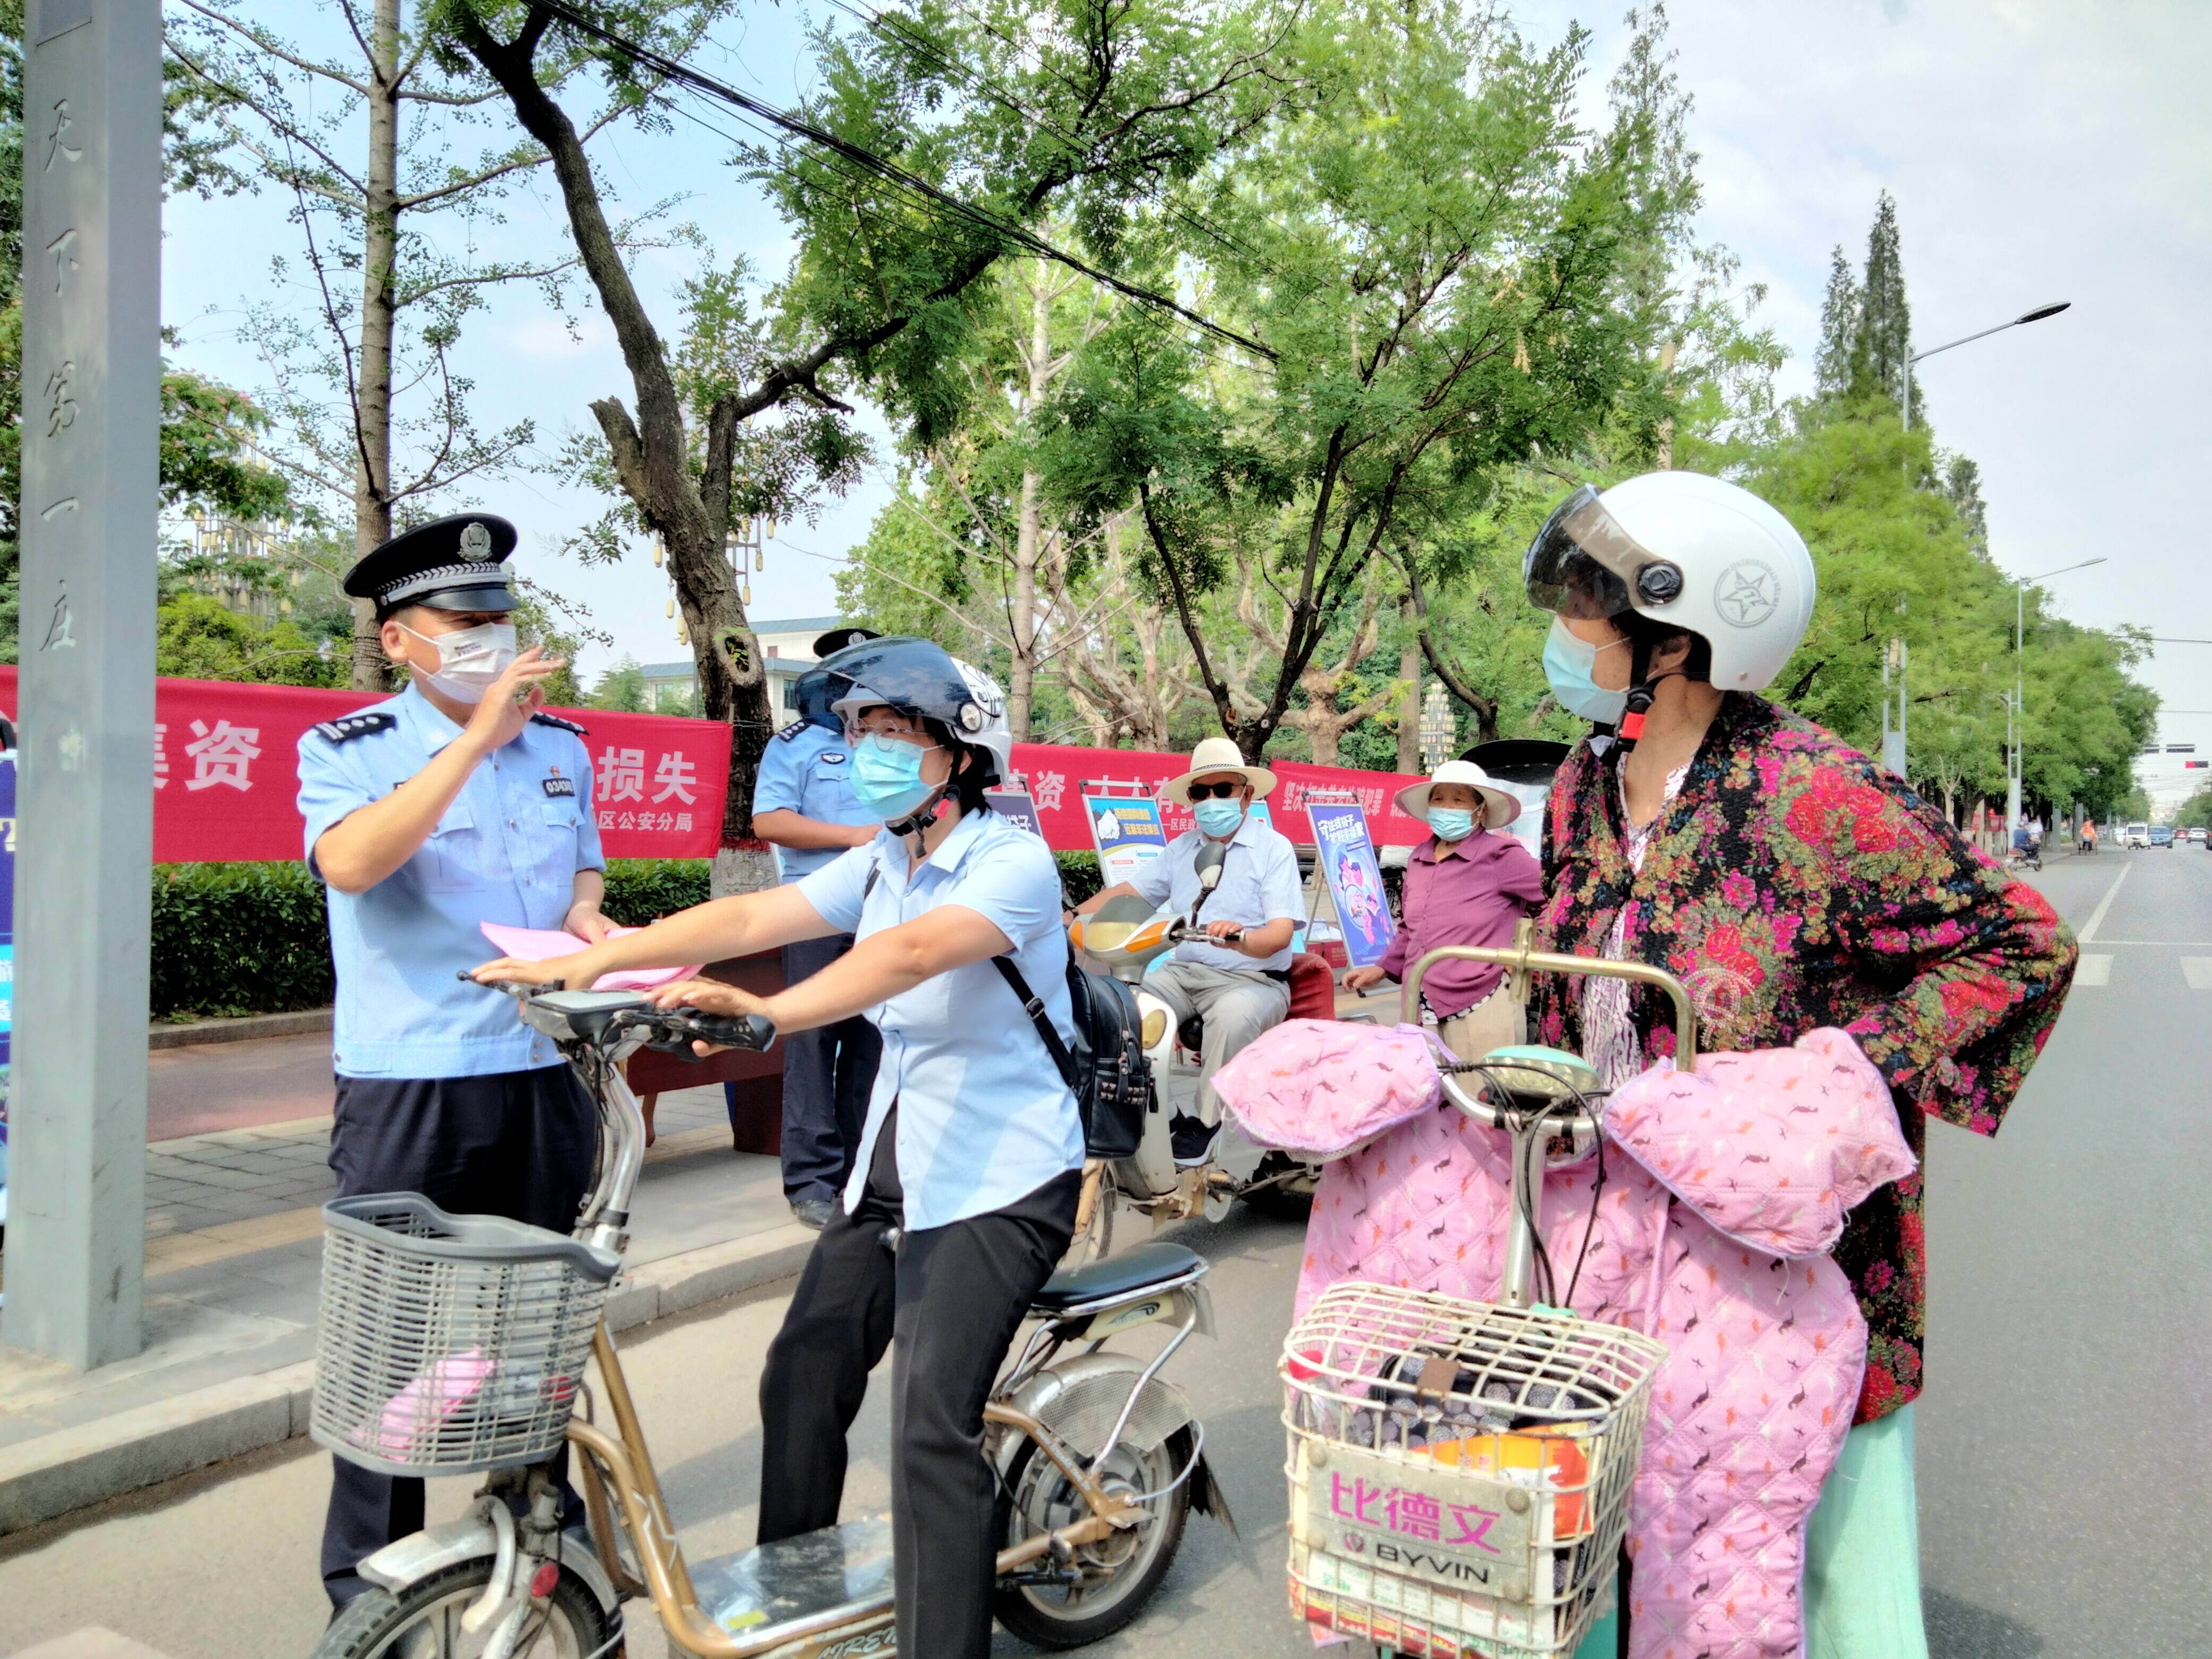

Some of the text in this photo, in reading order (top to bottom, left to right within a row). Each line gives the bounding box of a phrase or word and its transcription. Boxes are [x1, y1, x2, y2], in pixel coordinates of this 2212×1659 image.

[154, 719, 697, 806] 资 损失
[598, 810, 693, 832] 区公安分局
[1330, 1470, 1502, 1554] 比德文
[1376, 1543, 1488, 1584] BYVIN
